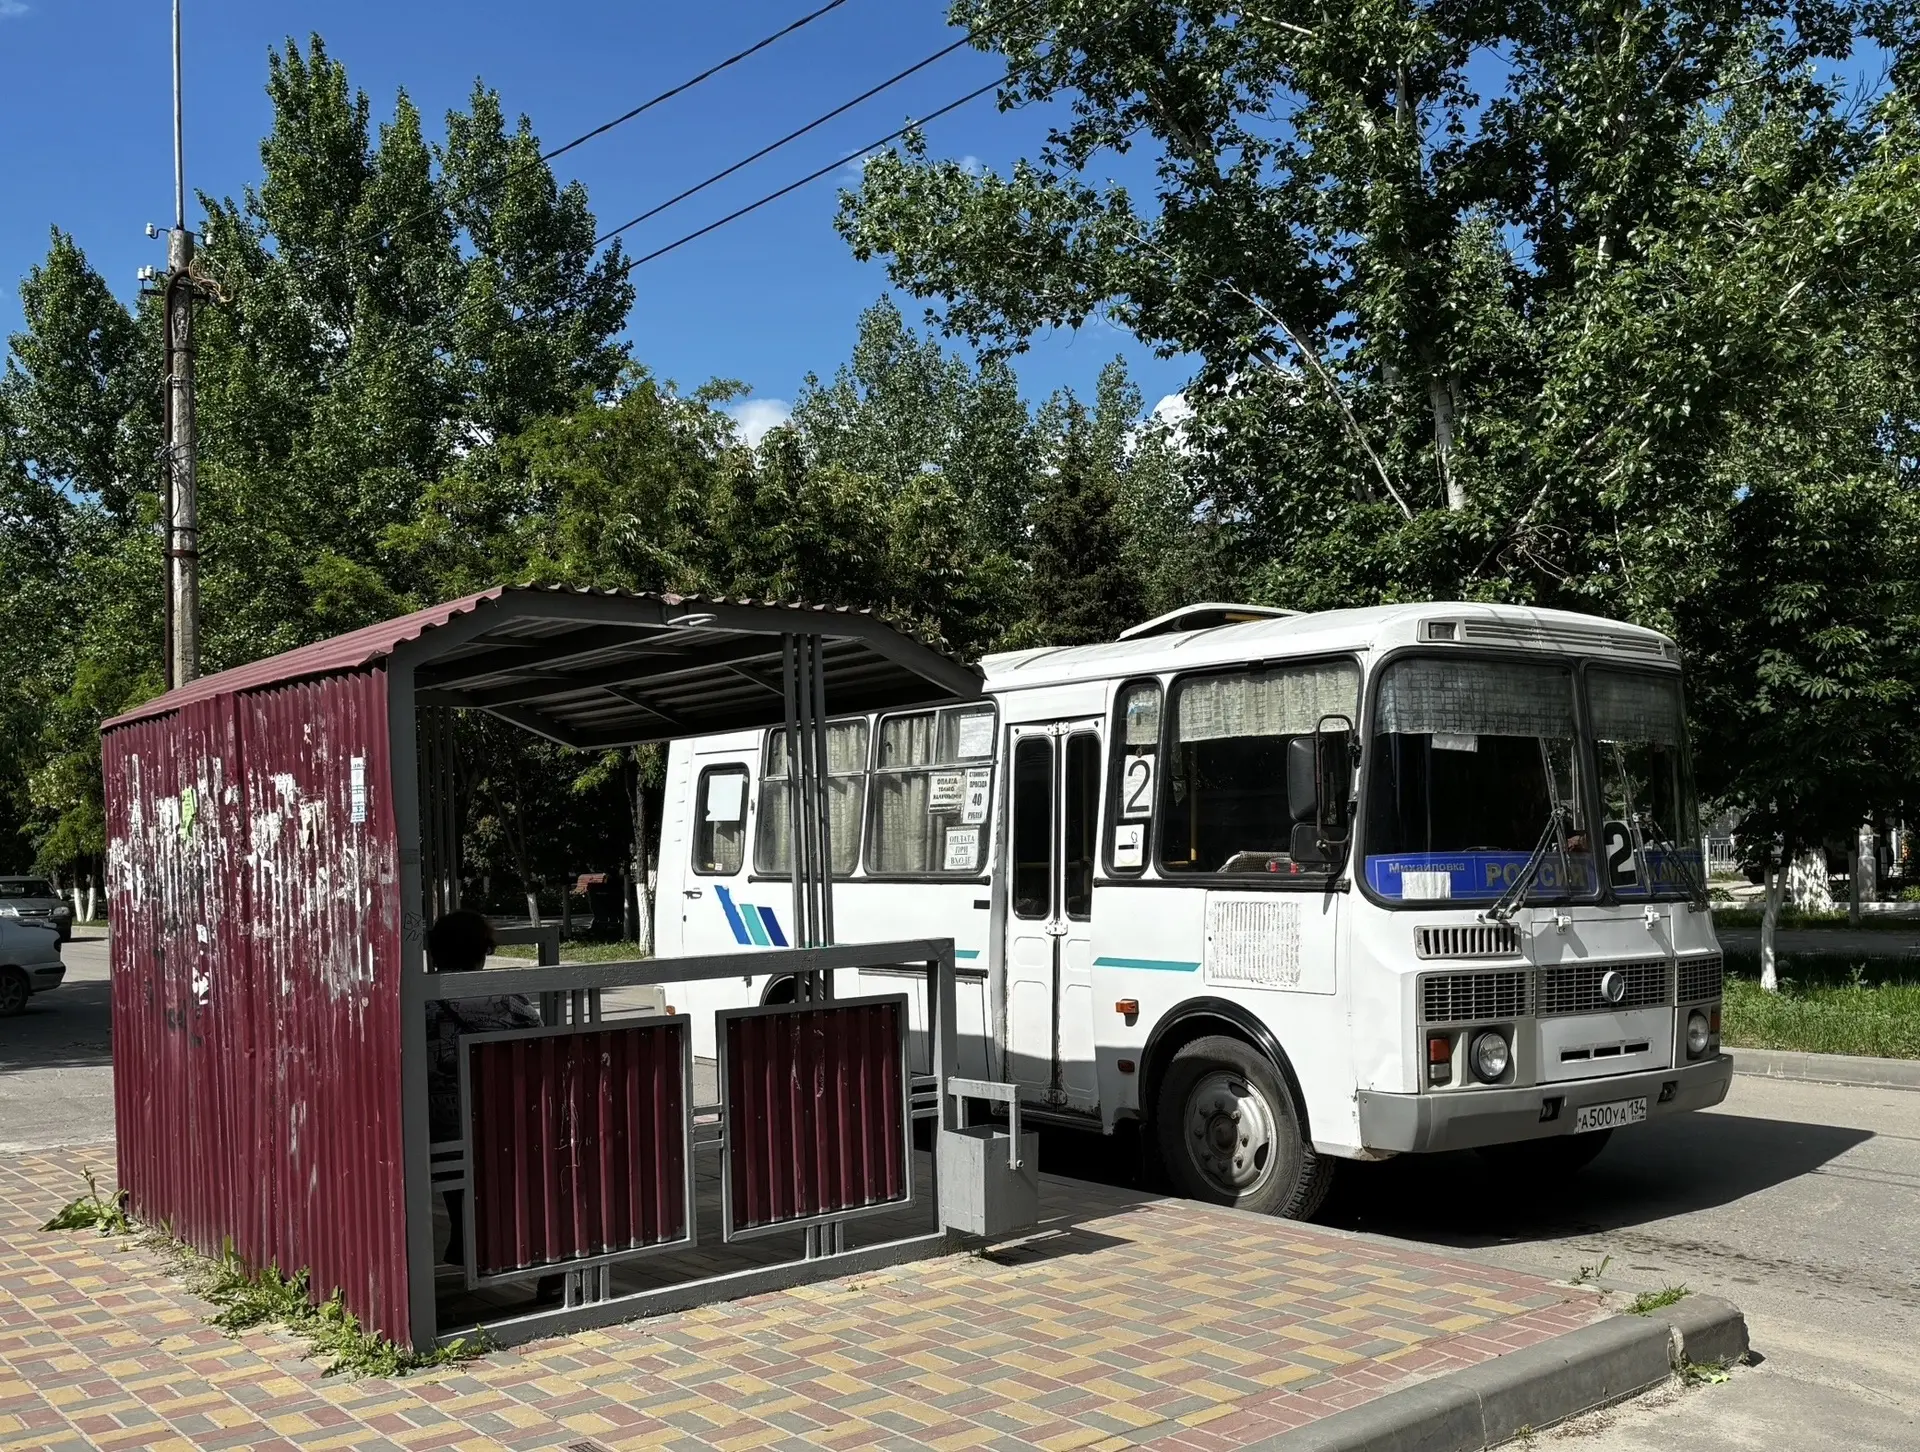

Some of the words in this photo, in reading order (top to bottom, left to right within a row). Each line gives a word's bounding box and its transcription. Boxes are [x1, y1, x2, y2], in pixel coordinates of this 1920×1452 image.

[972, 793, 982, 806] 40
[1126, 760, 1150, 813] 2
[949, 835, 975, 843] ОПЛАТА
[1604, 821, 1636, 886] 2
